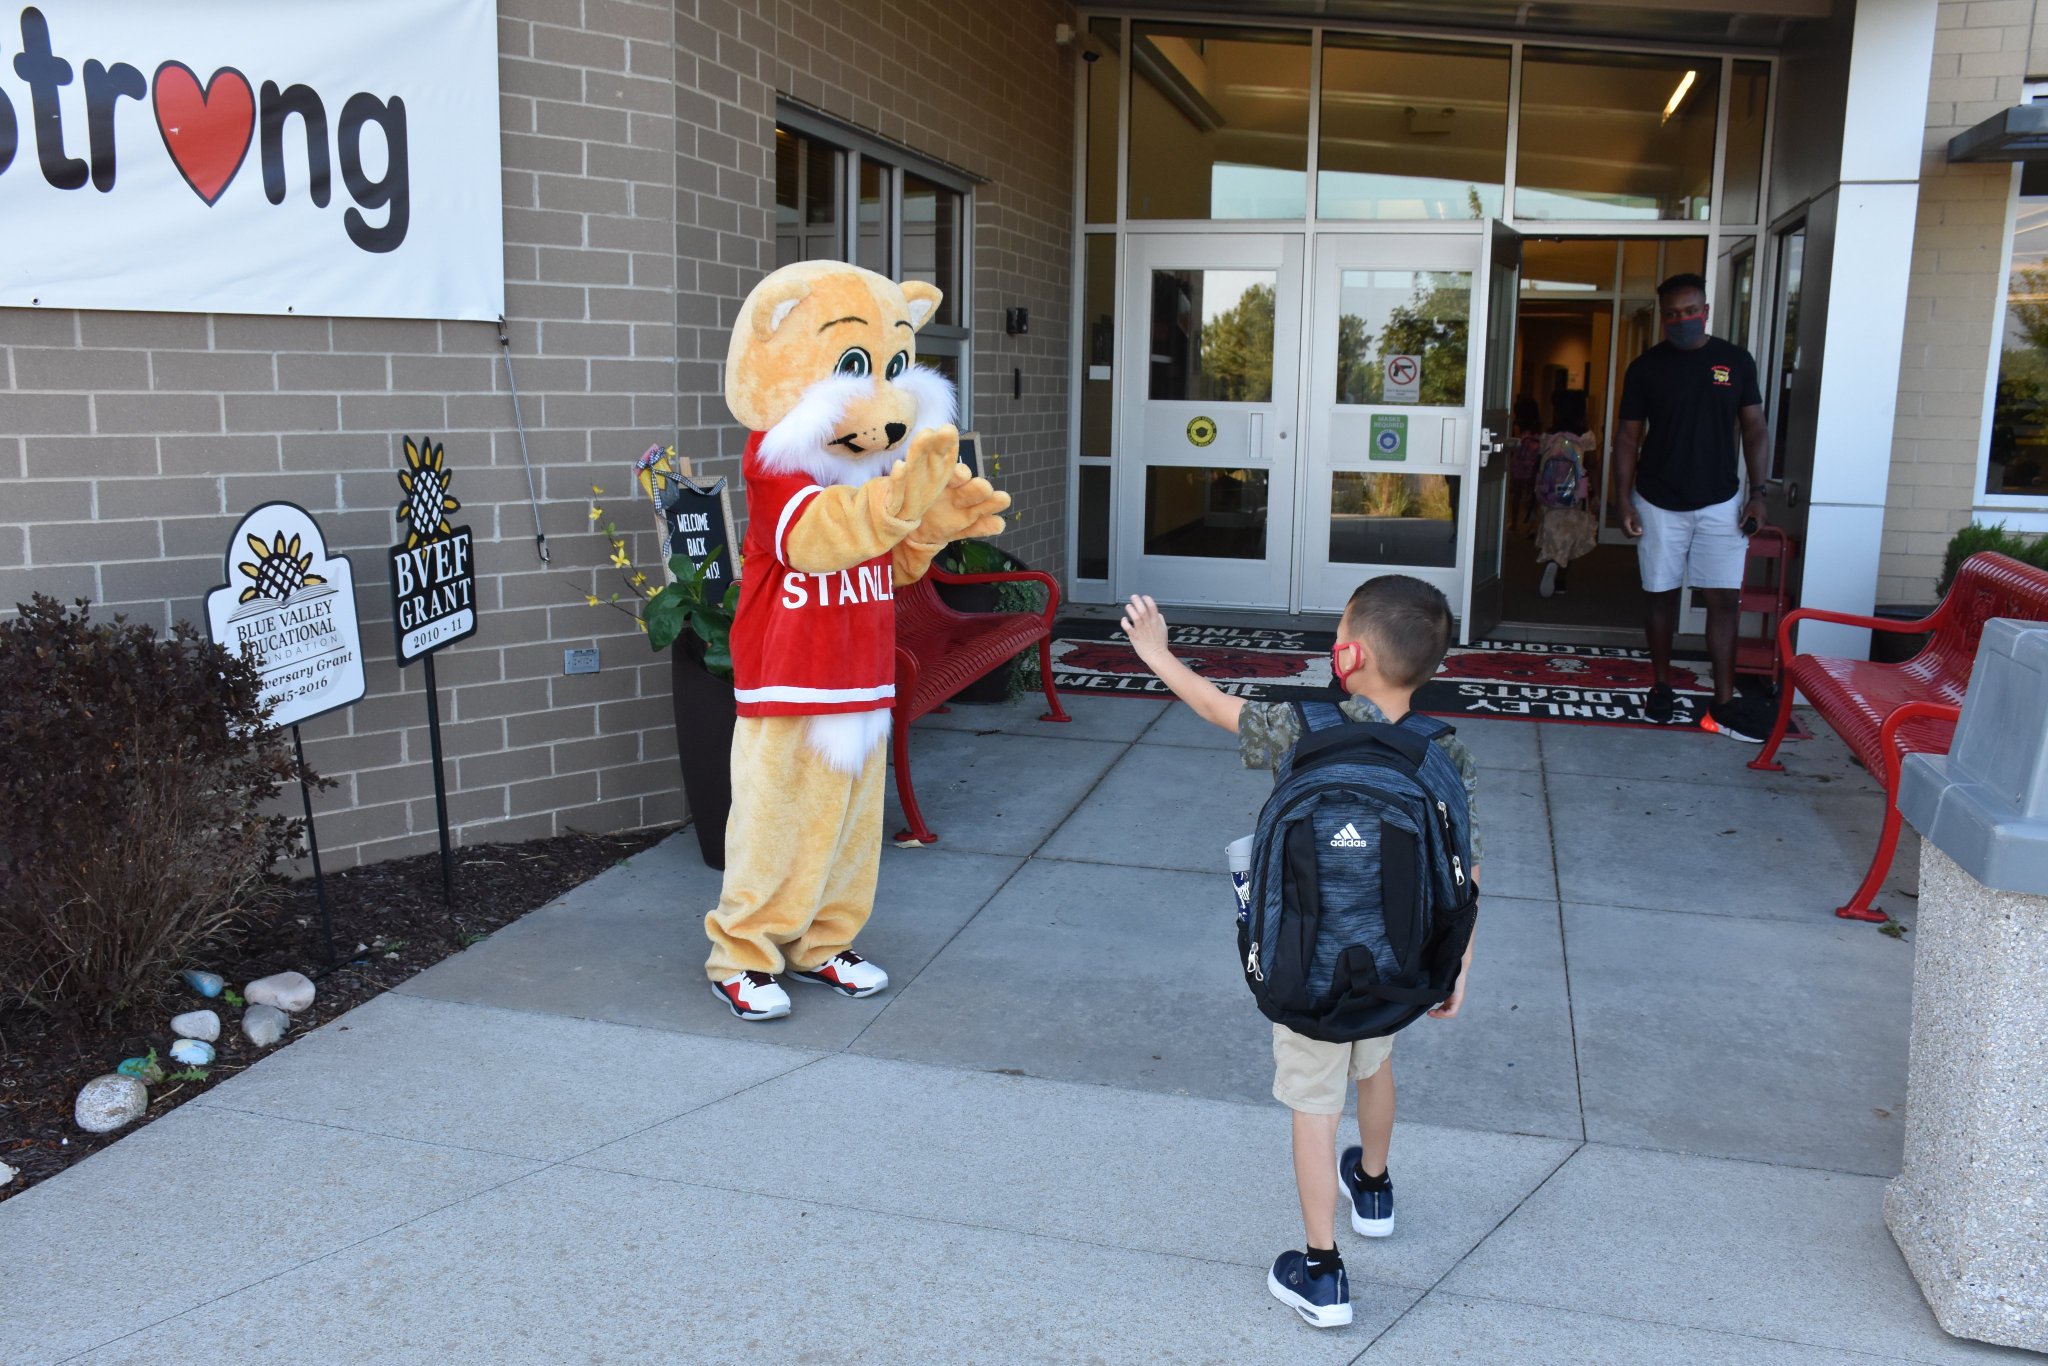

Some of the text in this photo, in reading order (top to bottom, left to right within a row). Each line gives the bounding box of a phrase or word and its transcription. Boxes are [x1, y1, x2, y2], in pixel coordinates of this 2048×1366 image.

[0, 6, 411, 253] trong
[676, 512, 710, 533] WELCOME
[686, 537, 708, 556] BACK
[394, 533, 469, 599] BVEF
[399, 577, 472, 631] GRANT
[236, 599, 333, 642] BLUE VALLEY
[413, 626, 440, 649] 2010
[451, 618, 462, 631] 11
[1168, 626, 1305, 640] ANLEY
[249, 618, 336, 656] DUCATIONAL
[264, 635, 338, 665] UNDATION
[317, 652, 353, 672] Grant
[1054, 673, 1272, 698] WELCME
[1458, 684, 1694, 708] WLDCATS
[1330, 838, 1367, 848] adidas
